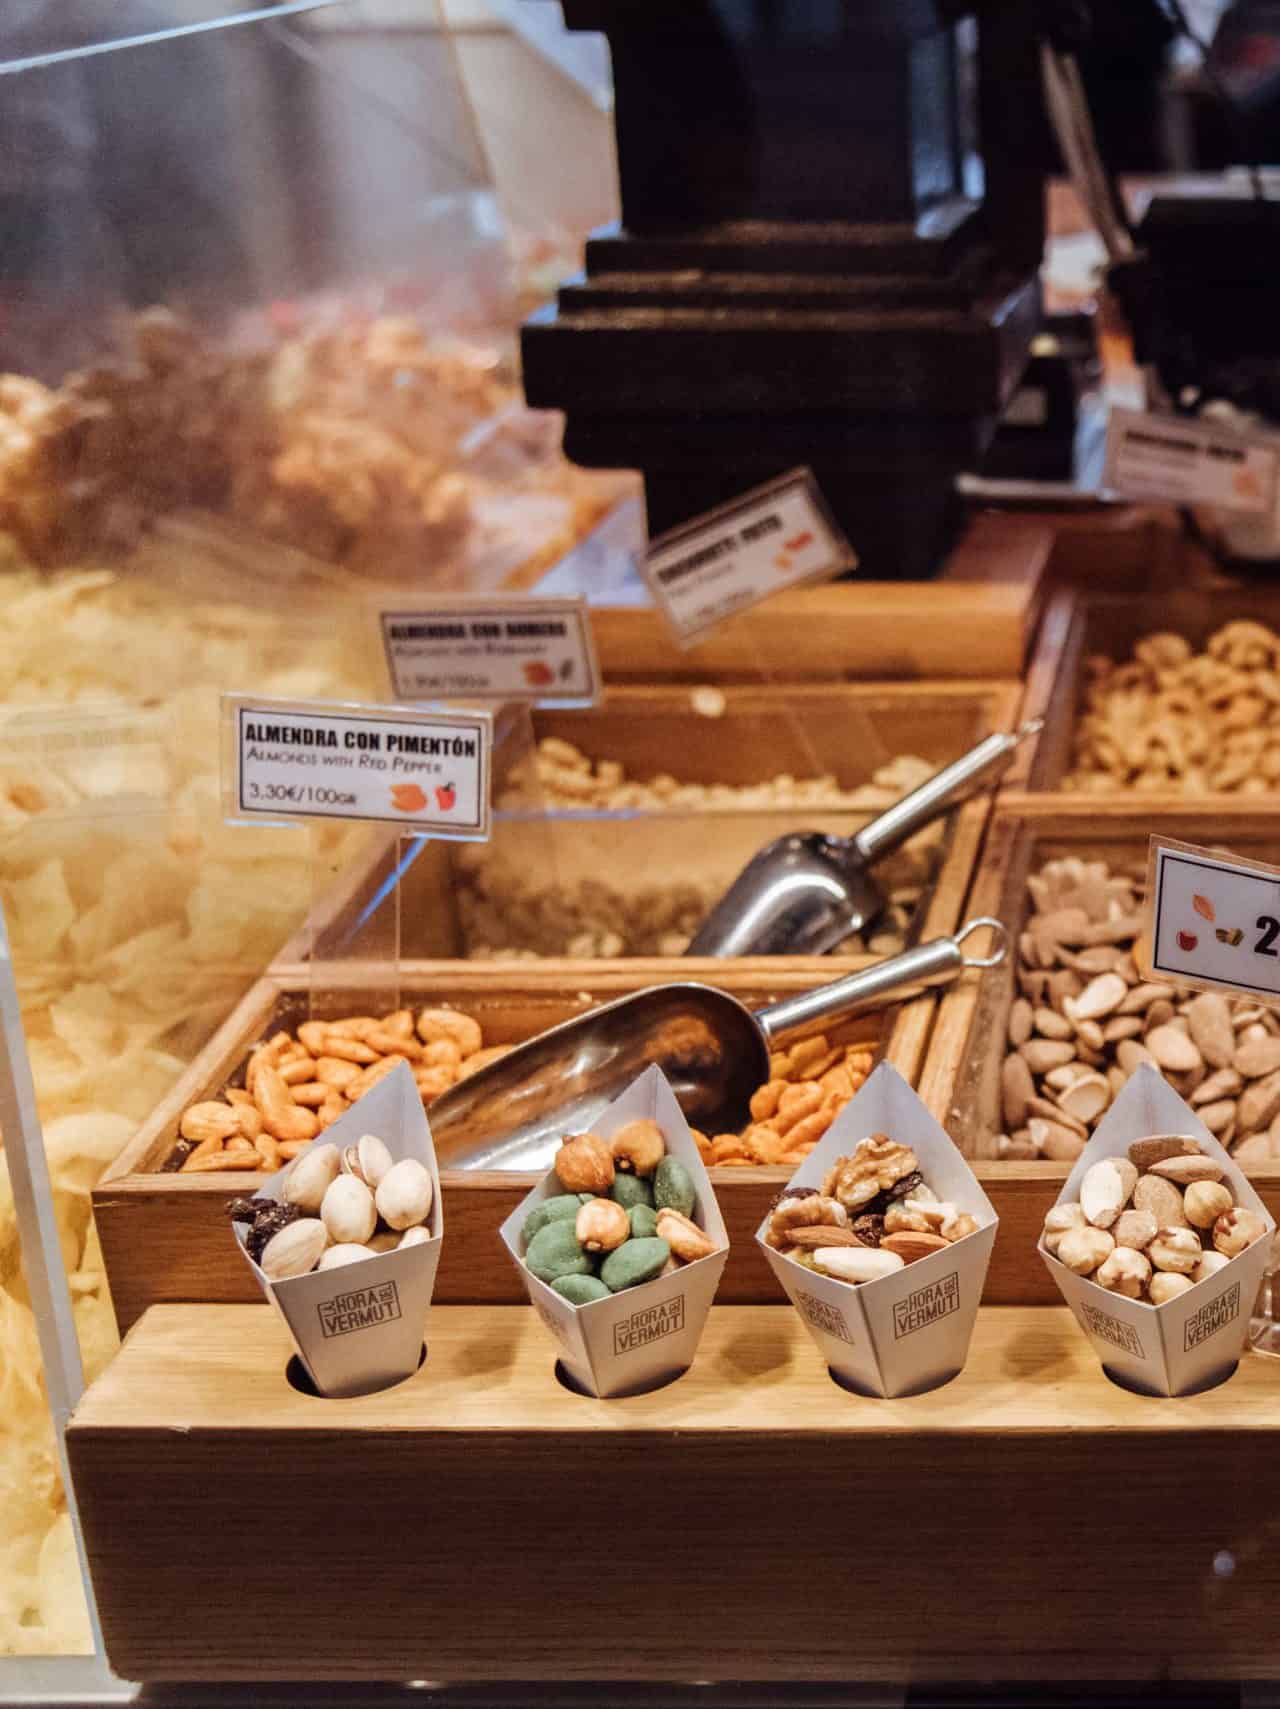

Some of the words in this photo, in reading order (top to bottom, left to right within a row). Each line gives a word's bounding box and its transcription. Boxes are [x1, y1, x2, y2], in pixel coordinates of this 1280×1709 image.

[246, 723, 338, 747] ALMENDRA
[344, 731, 381, 750] CON
[386, 734, 476, 758] PIMENTÓN
[246, 747, 317, 767] ALMONDS
[322, 757, 353, 768] WITH
[358, 755, 387, 770] RED
[392, 757, 442, 774] PEPPER
[336, 1290, 378, 1313] HORA
[898, 1293, 957, 1332] VERMUT
[909, 1284, 943, 1312] HORA
[325, 1302, 394, 1333] VERMUT
[618, 1314, 681, 1349] VERMUT
[631, 1307, 667, 1329] HORA
[1188, 1305, 1235, 1345] VERMUT
